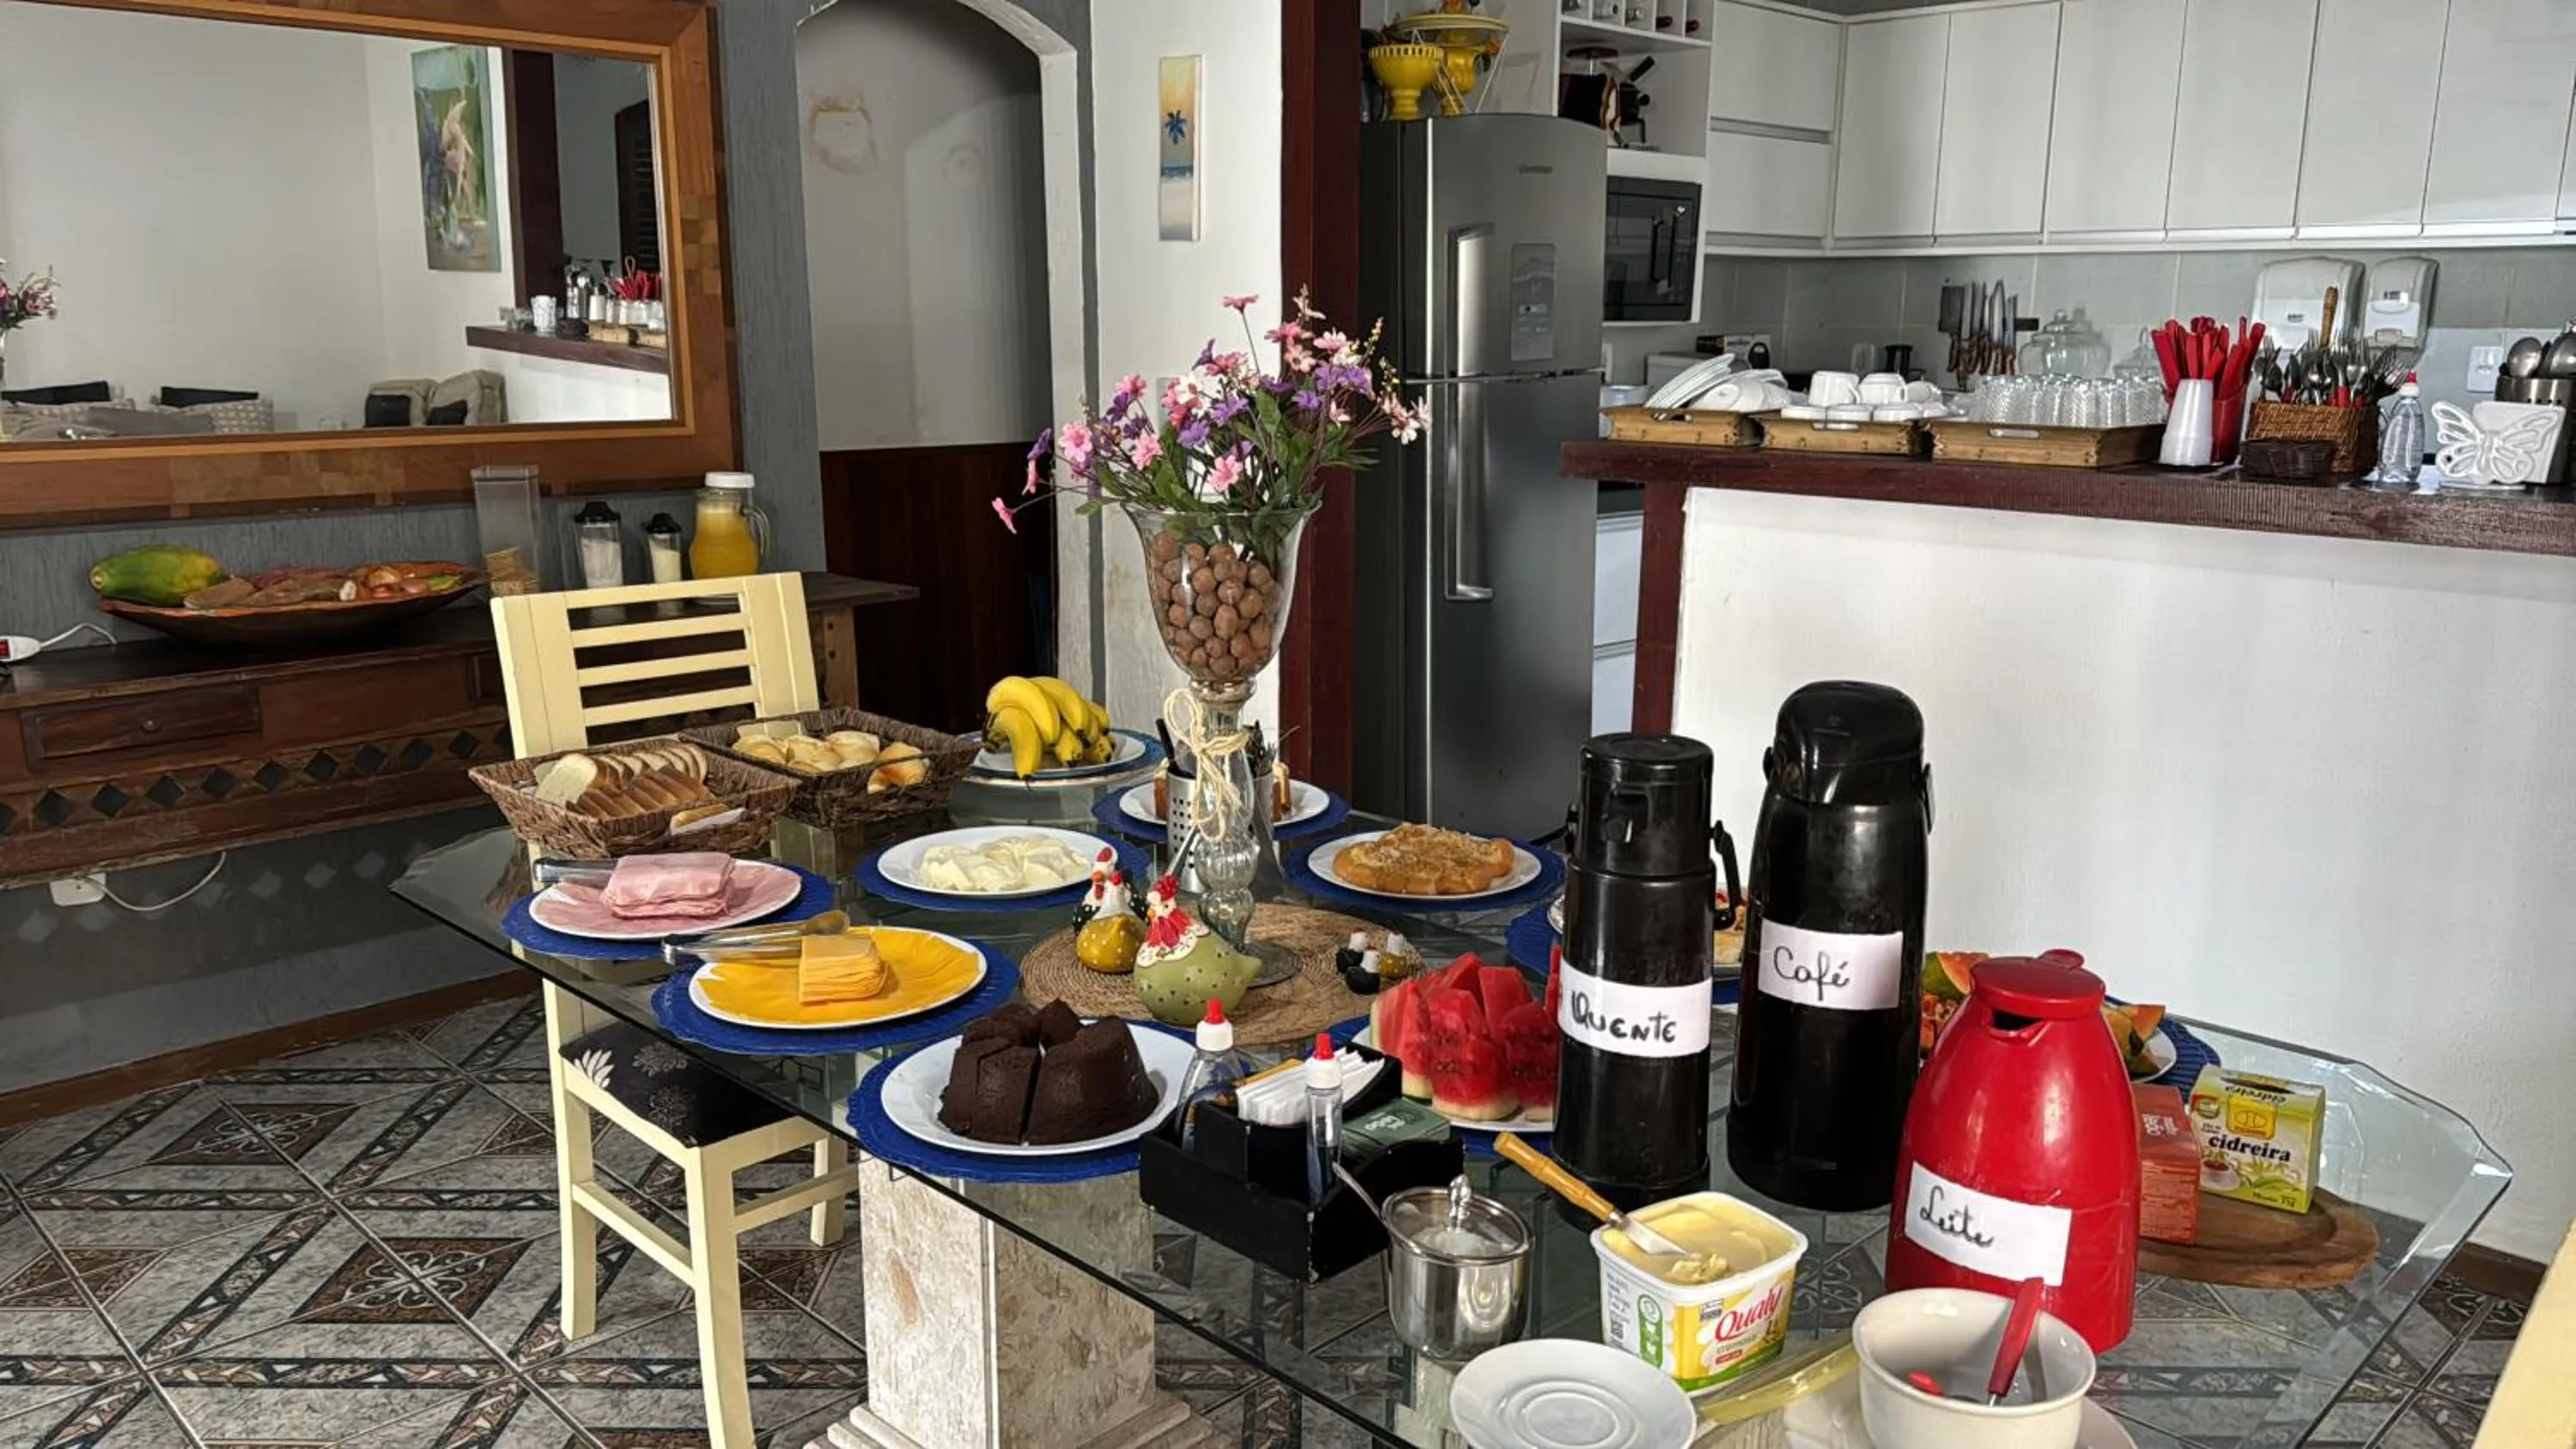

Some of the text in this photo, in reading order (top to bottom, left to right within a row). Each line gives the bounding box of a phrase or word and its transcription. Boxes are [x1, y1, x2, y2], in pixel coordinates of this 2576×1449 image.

[1773, 945, 1851, 1002] Café
[2208, 1134, 2292, 1162] cidreira
[1919, 1185, 1995, 1248] Leite
[1715, 1286, 1783, 1343] Qualy
